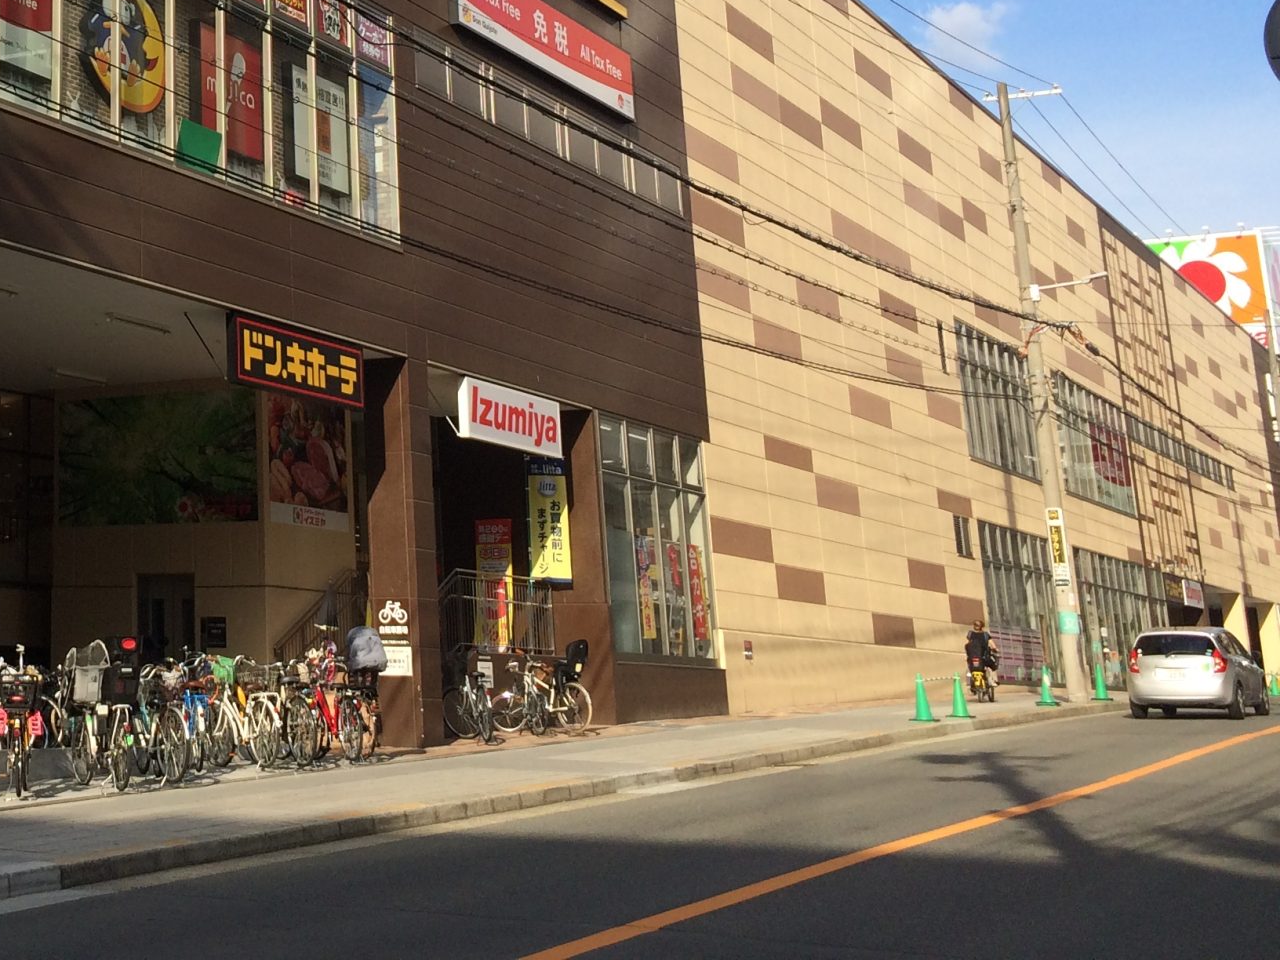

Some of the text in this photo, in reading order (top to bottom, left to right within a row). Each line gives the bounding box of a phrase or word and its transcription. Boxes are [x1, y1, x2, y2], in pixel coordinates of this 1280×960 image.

[533, 10, 569, 56] 免税
[580, 44, 591, 63] All
[591, 50, 606, 73] Tax
[606, 59, 623, 81] Free
[206, 76, 255, 110] mjica
[471, 385, 557, 447] Izumiya
[537, 508, 549, 574] まずチャージ
[549, 500, 564, 563] お買物前に
